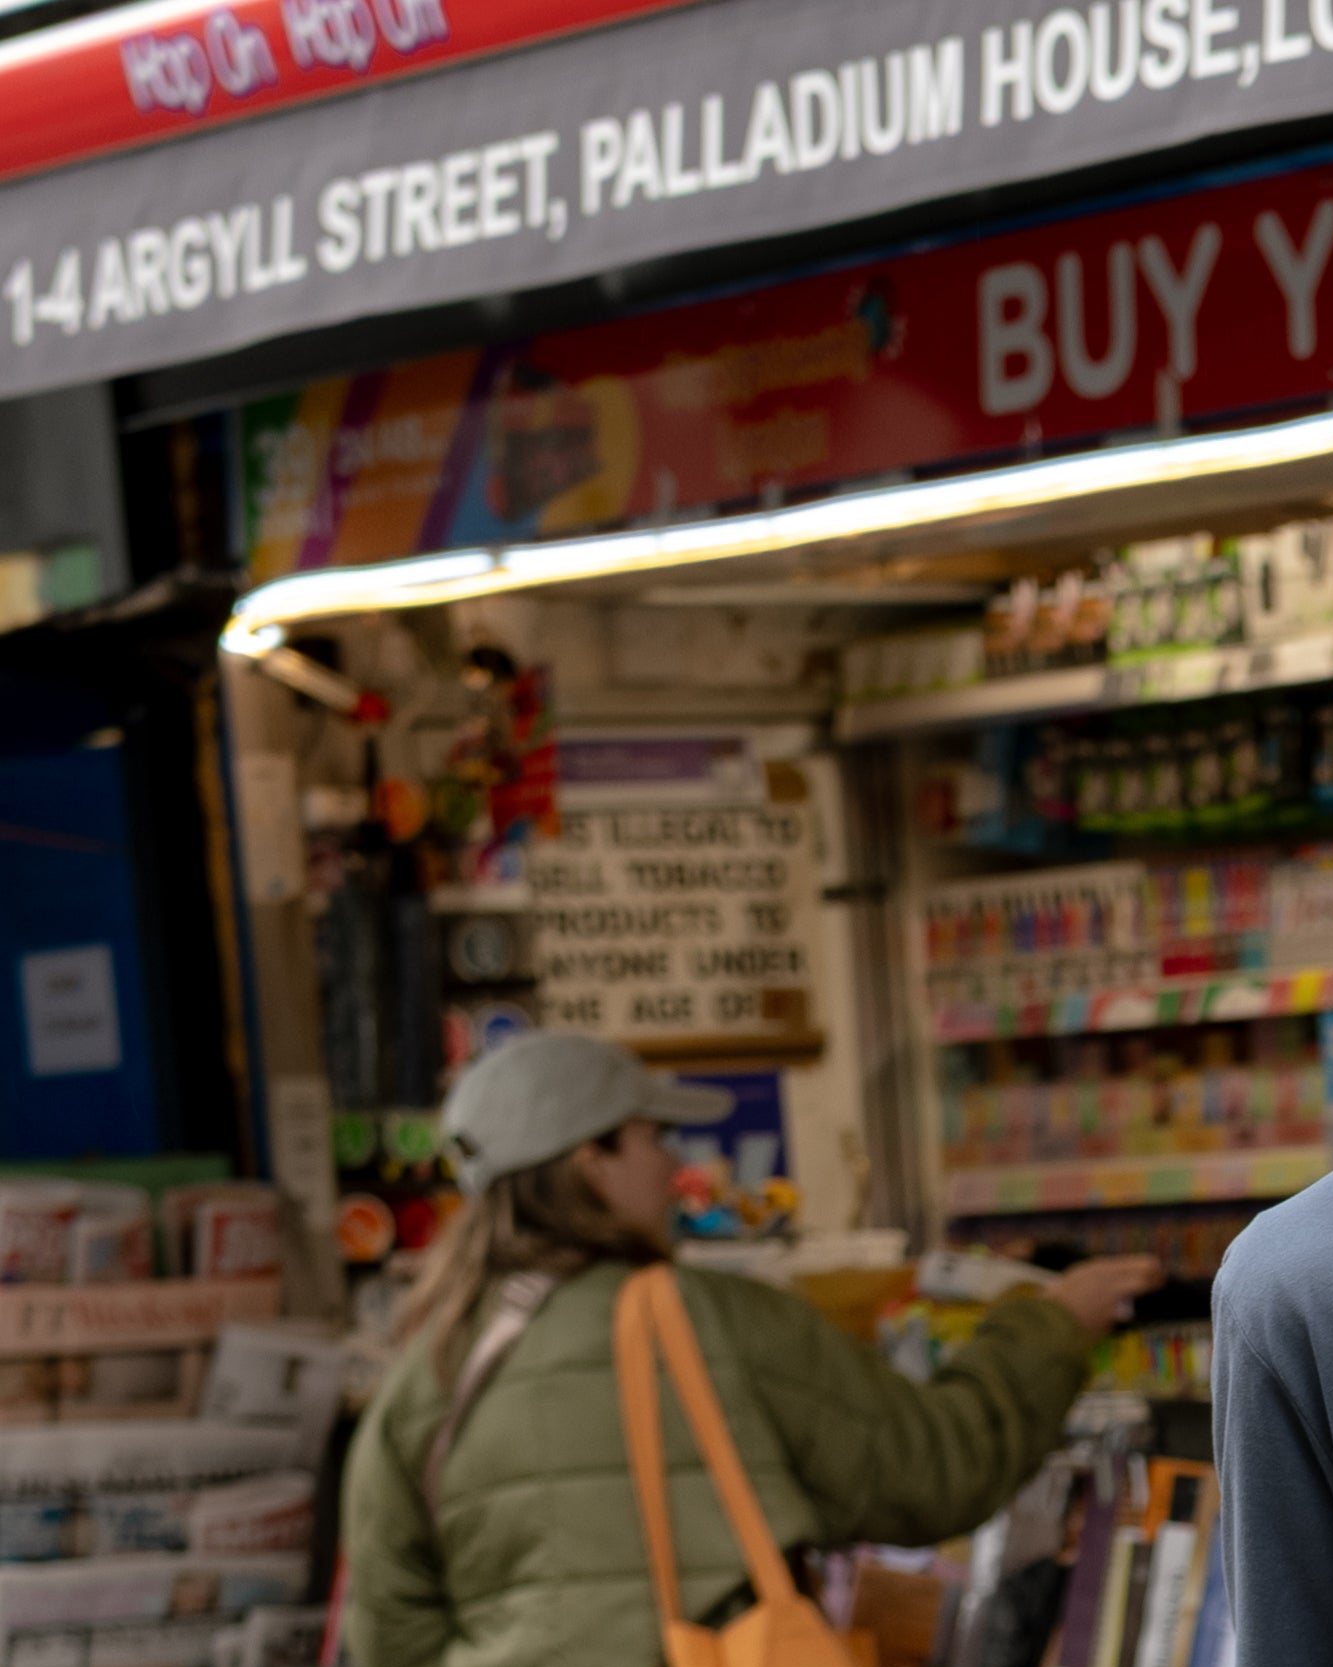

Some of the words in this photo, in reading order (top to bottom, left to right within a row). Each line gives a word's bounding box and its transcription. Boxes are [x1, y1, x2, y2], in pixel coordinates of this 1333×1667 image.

[120, 30, 212, 118] Hop
[203, 5, 279, 98] On
[3, 247, 83, 347] 1-4
[87, 198, 310, 330] ARGYLL
[315, 130, 567, 273] STREET,
[579, 36, 964, 217] PALLADIUM
[978, 222, 1222, 417] BUY
